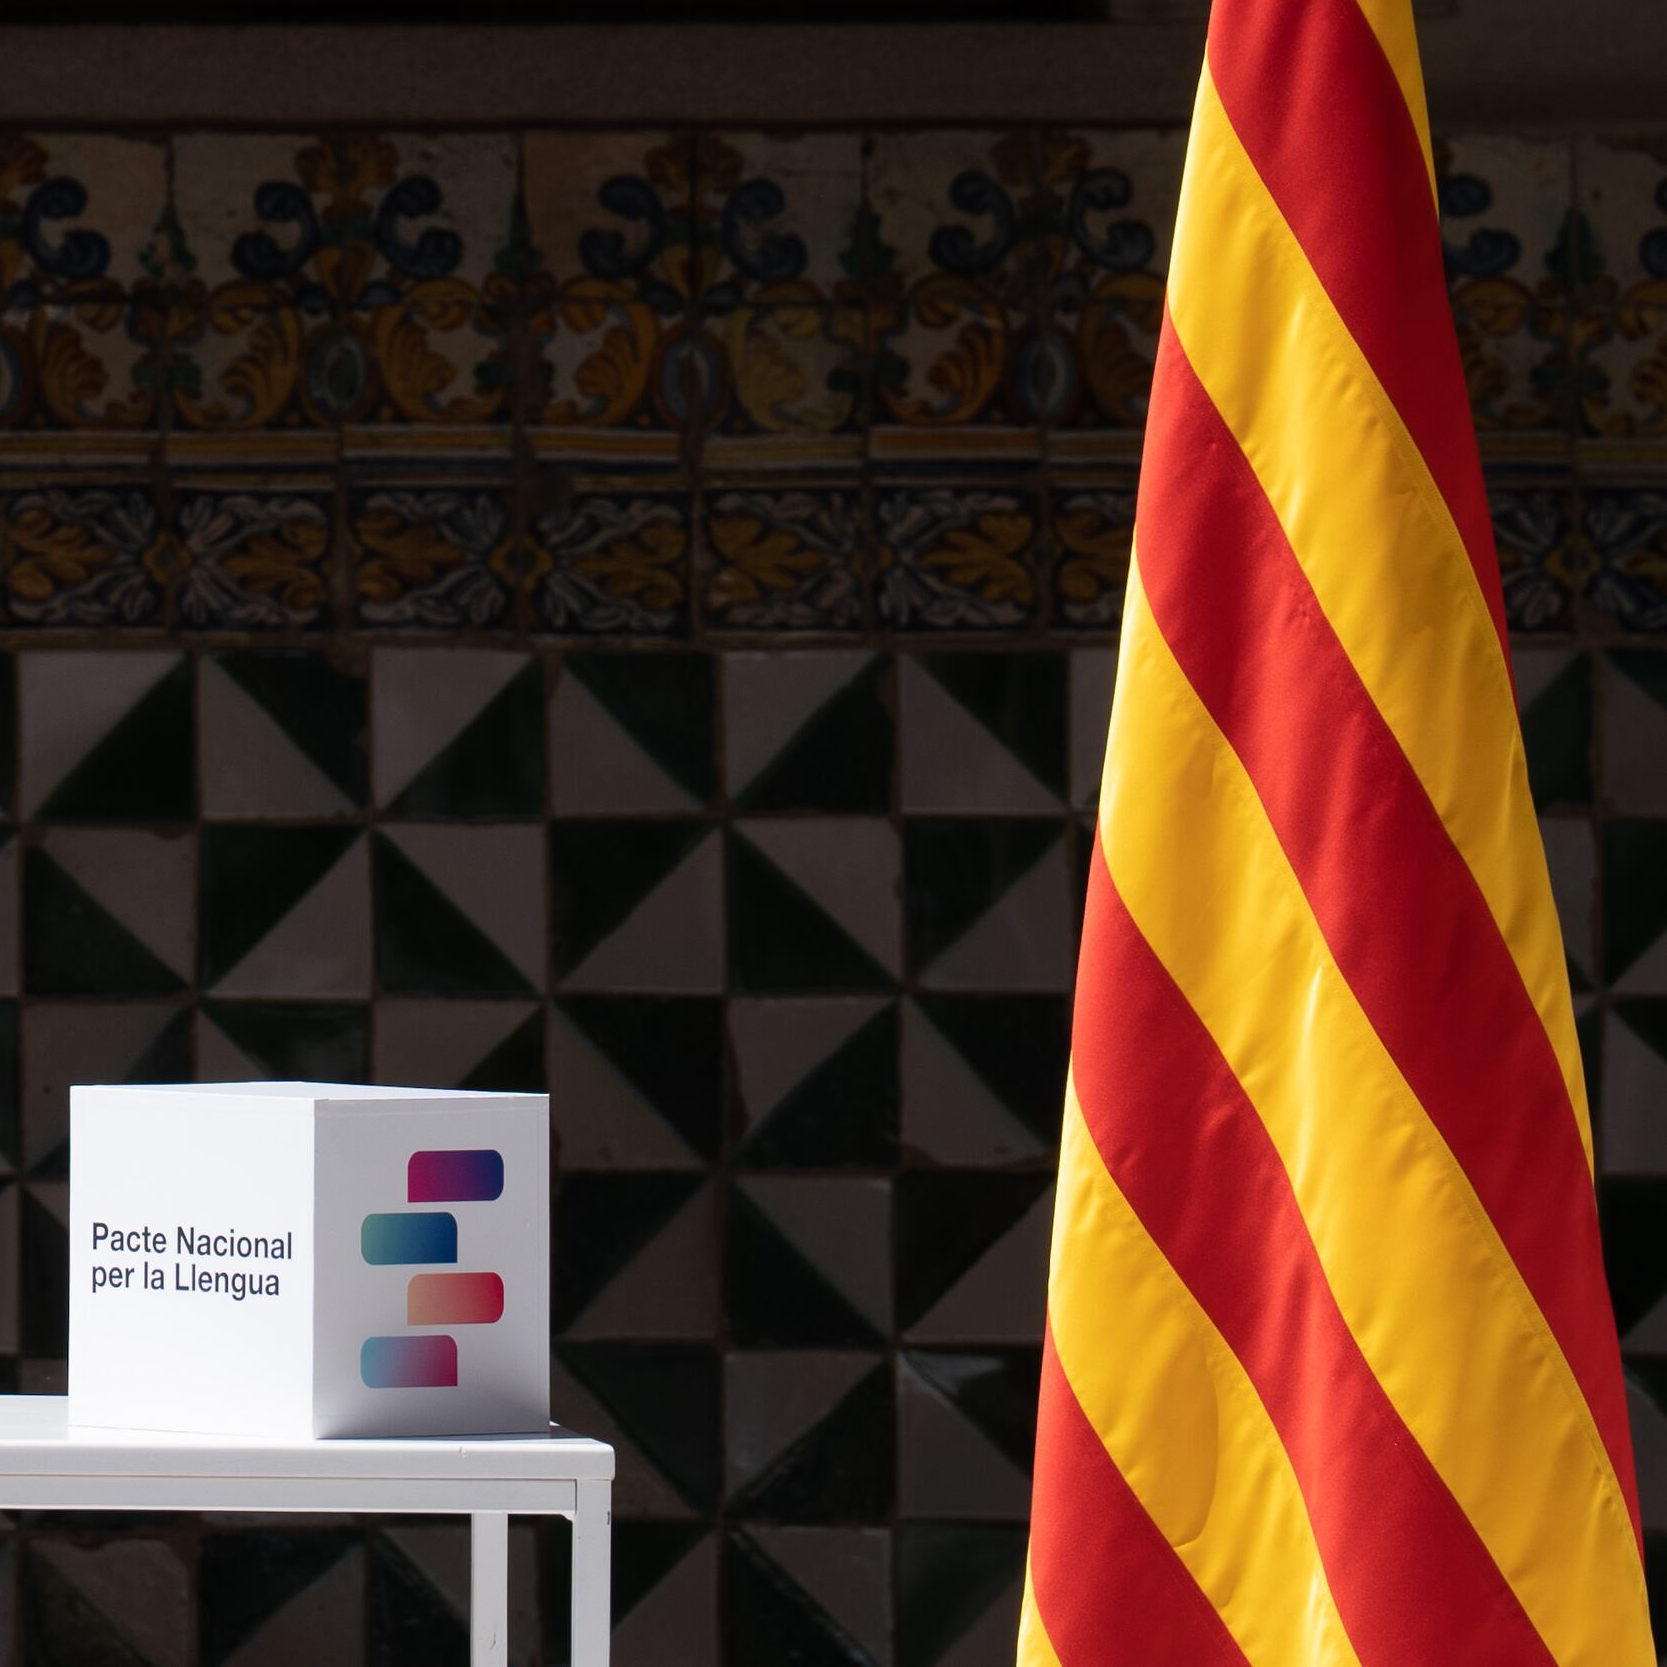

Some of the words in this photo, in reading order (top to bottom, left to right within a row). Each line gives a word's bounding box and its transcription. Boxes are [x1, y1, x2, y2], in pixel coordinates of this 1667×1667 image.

[92, 1221, 167, 1254] Pacte
[177, 1226, 292, 1260] Nacional
[92, 1266, 135, 1294] per
[143, 1261, 165, 1291] la
[175, 1262, 280, 1302] Llengua
